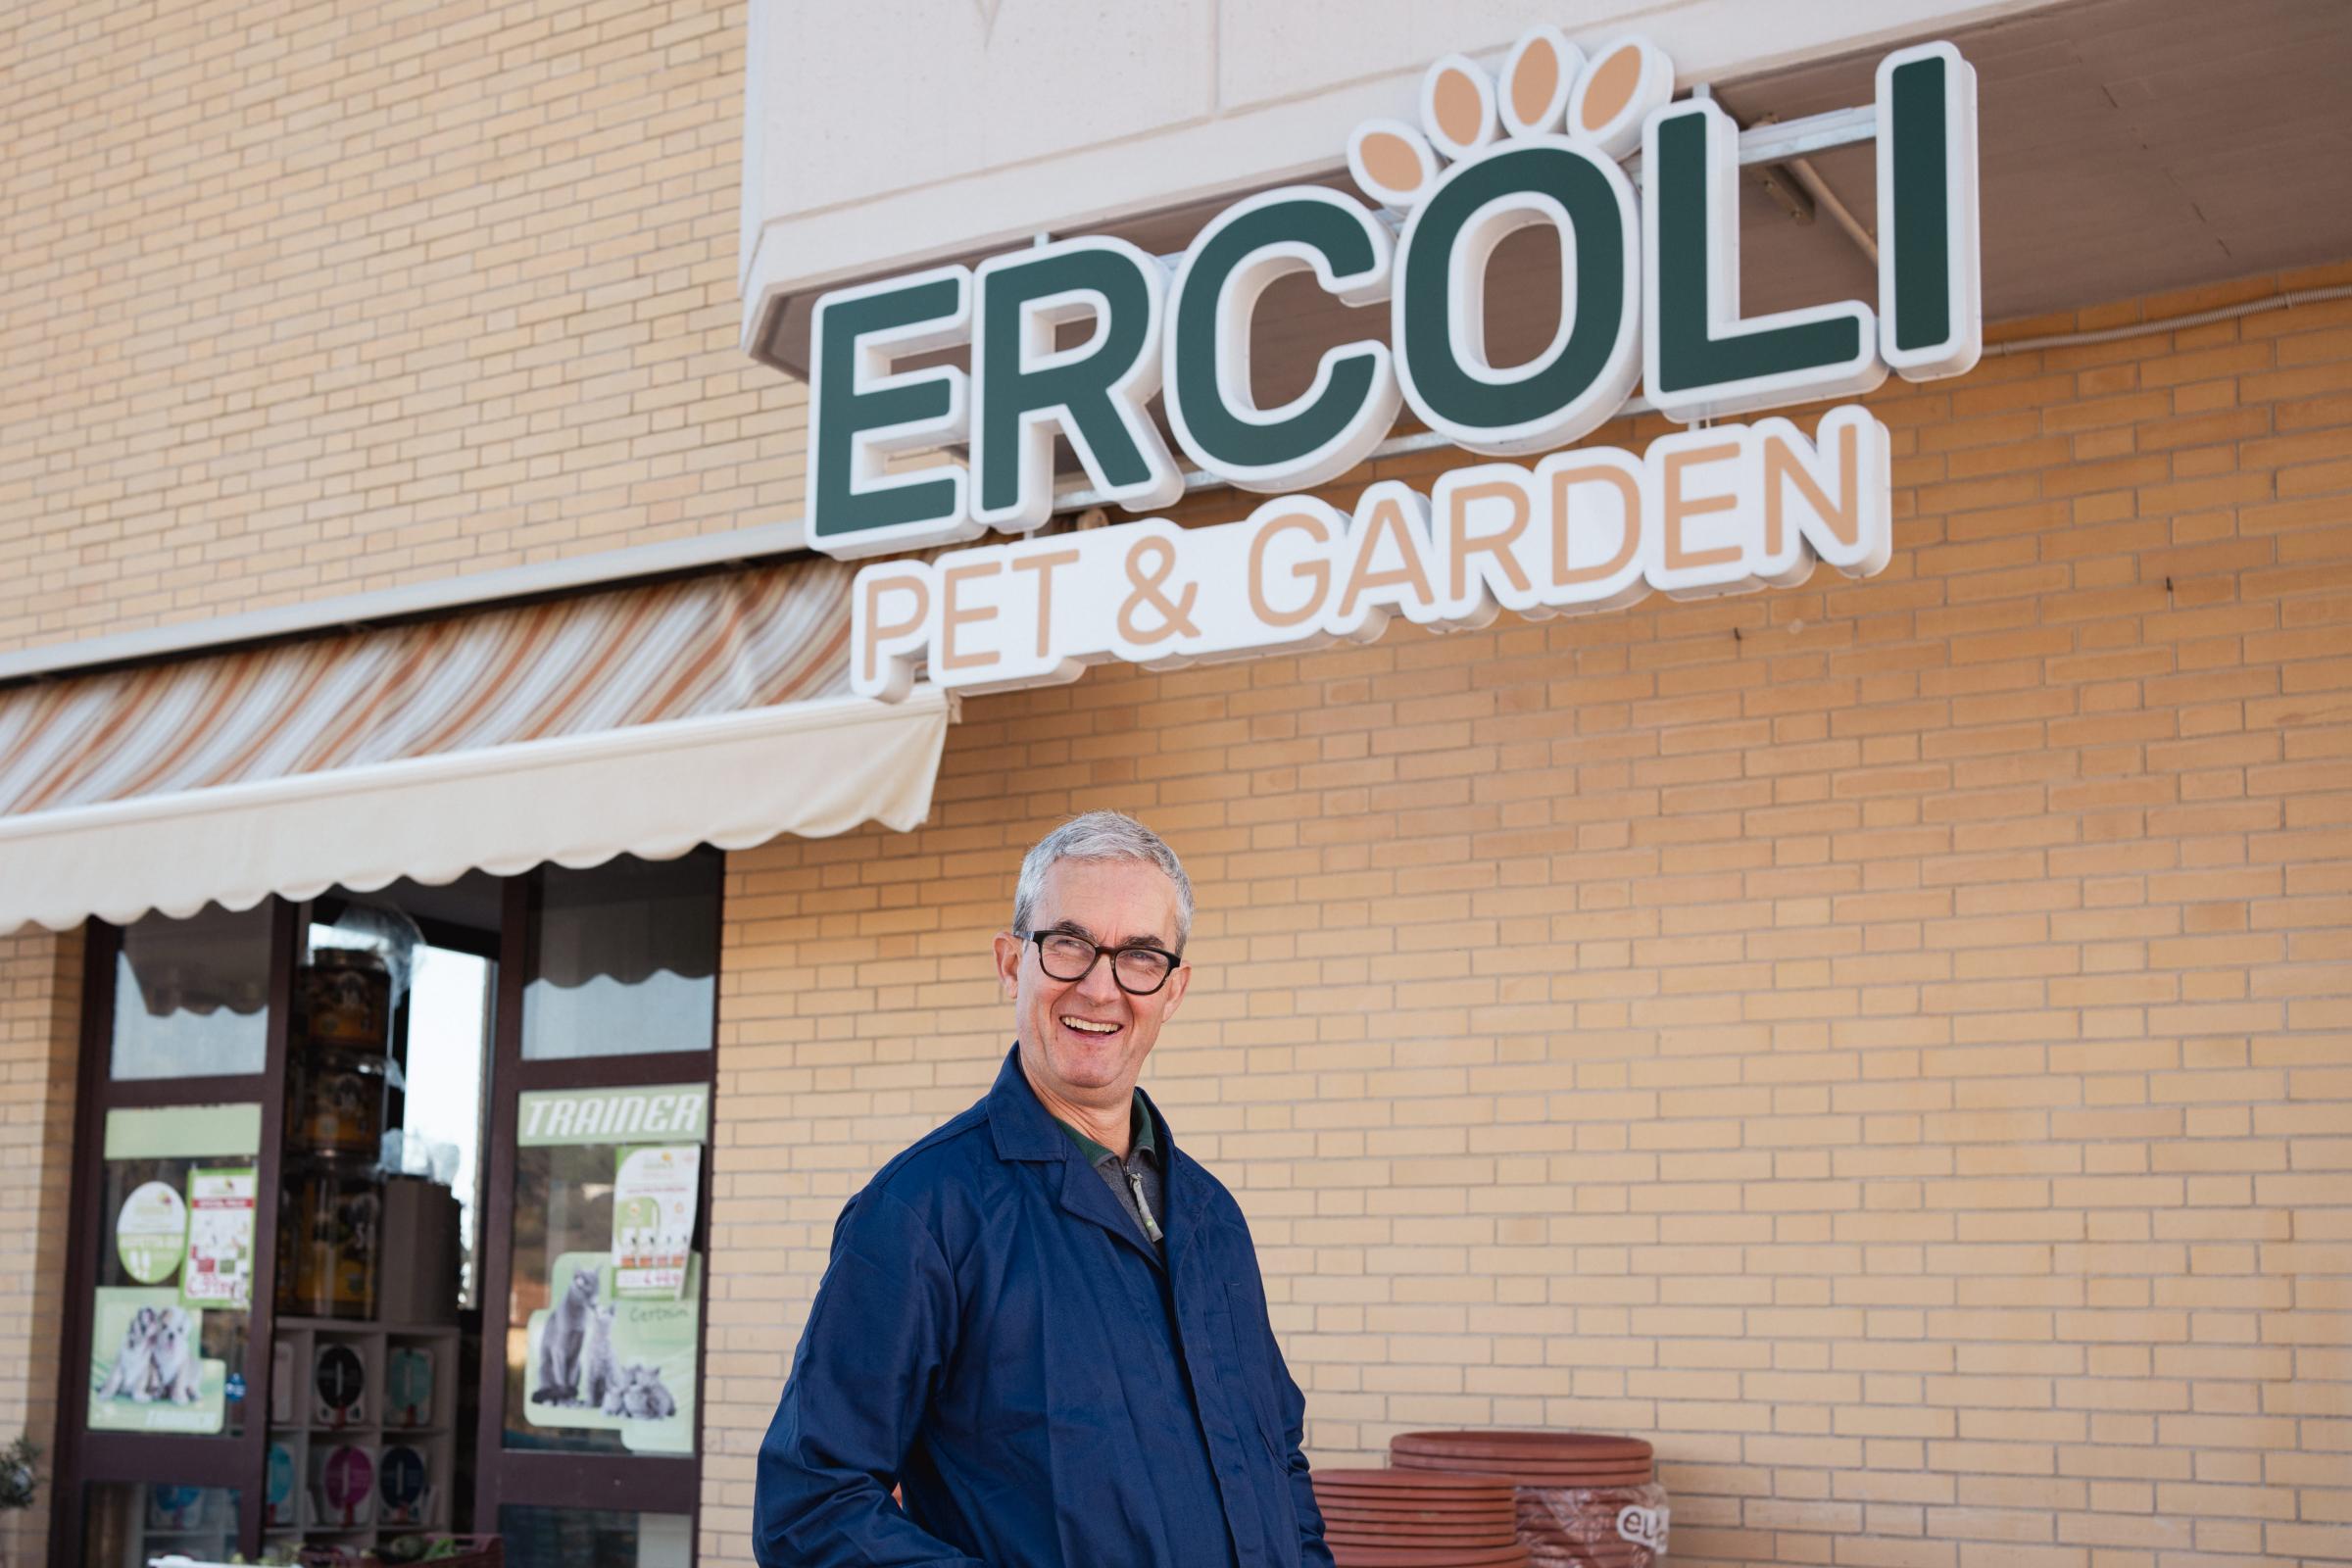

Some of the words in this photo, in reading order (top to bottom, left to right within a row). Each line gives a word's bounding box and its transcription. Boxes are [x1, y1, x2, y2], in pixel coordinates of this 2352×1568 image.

[814, 56, 1950, 536] ERCOLI
[864, 549, 1079, 680] PET
[1117, 536, 1201, 645] &
[1249, 422, 1858, 627] GARDEN
[526, 1093, 703, 1138] TRAINER
